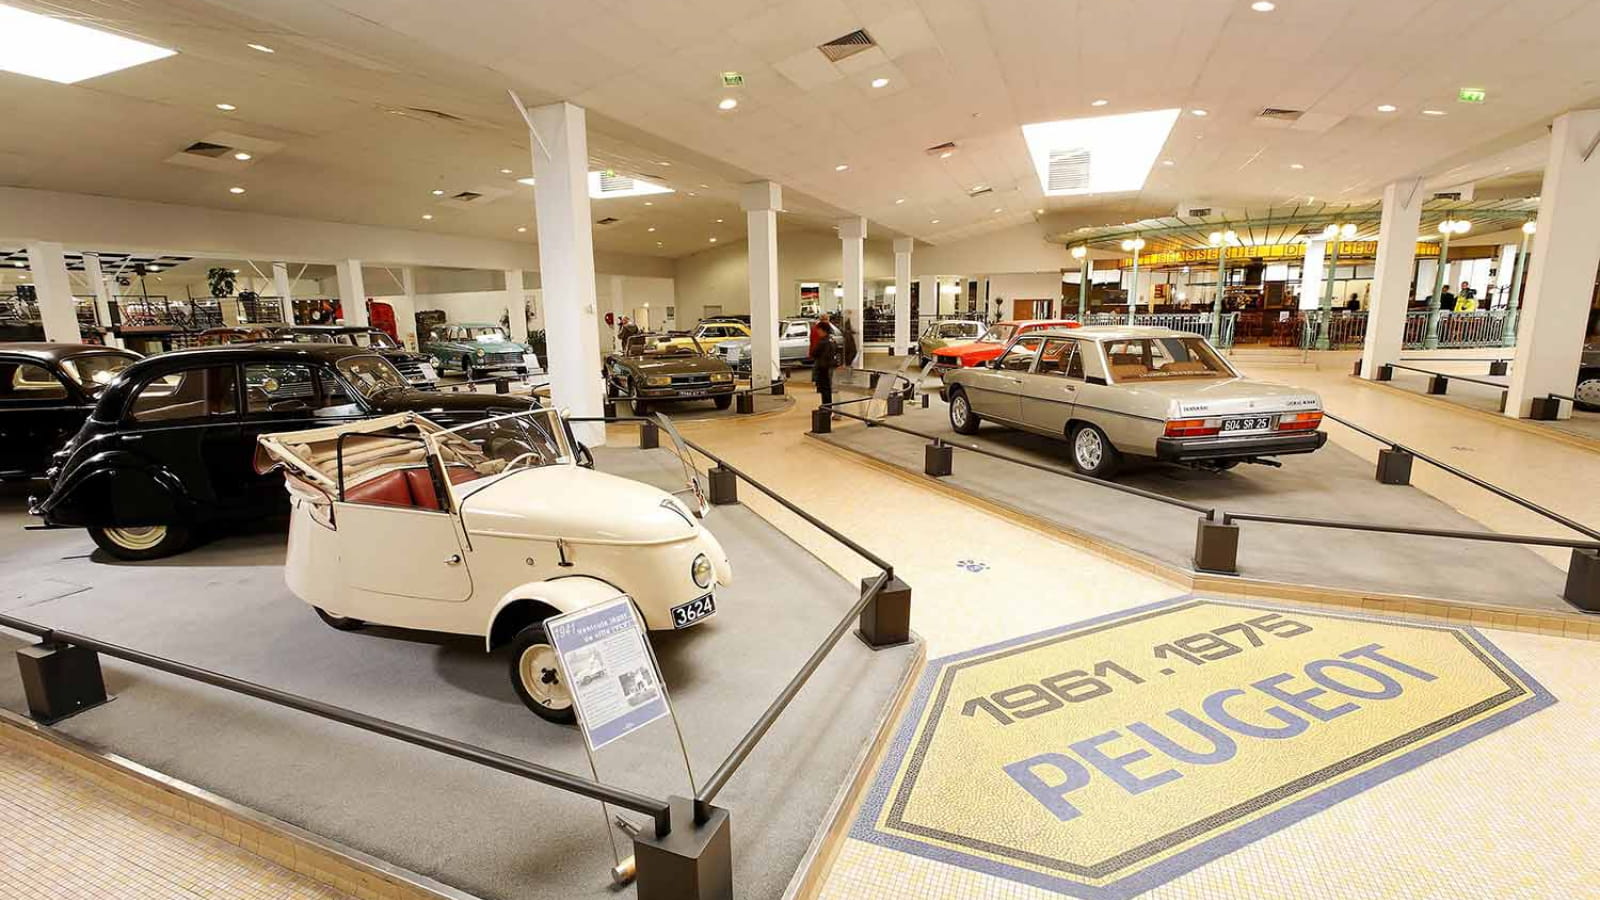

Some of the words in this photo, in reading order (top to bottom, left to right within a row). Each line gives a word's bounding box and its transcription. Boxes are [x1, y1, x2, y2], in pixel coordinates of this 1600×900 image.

[1225, 420, 1240, 431] 604
[1243, 419, 1254, 430] SR
[1256, 418, 1267, 429] 25
[676, 597, 712, 624] 3624
[1002, 643, 1439, 821] PEUGEOT
